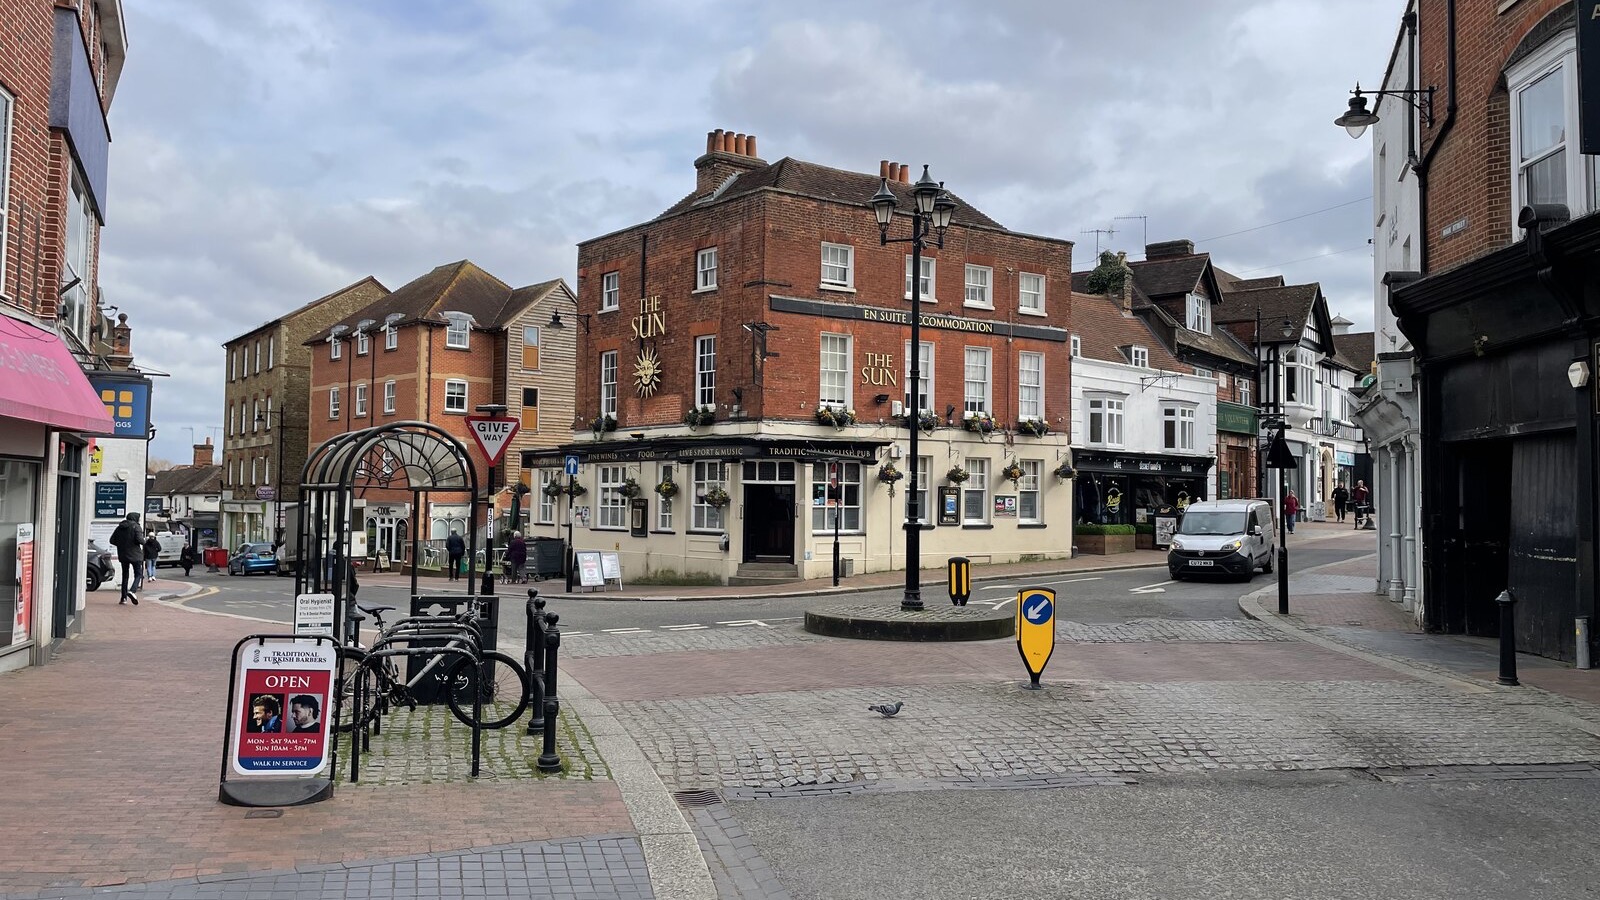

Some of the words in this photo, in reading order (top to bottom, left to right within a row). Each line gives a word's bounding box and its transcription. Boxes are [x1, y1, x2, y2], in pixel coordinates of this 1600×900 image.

[640, 295, 660, 314] THE
[630, 311, 666, 342] SUN
[864, 309, 877, 320] EN
[880, 310, 907, 323] SUITE
[910, 315, 993, 333] CCOMMODATION
[865, 352, 893, 368] THE
[861, 367, 898, 387] SUN
[477, 422, 509, 433] GIVE
[483, 433, 504, 441] WAY
[601, 452, 618, 460] WINES
[680, 449, 693, 457] LIVE
[377, 506, 391, 516] COOK
[265, 675, 310, 688] OPEN
